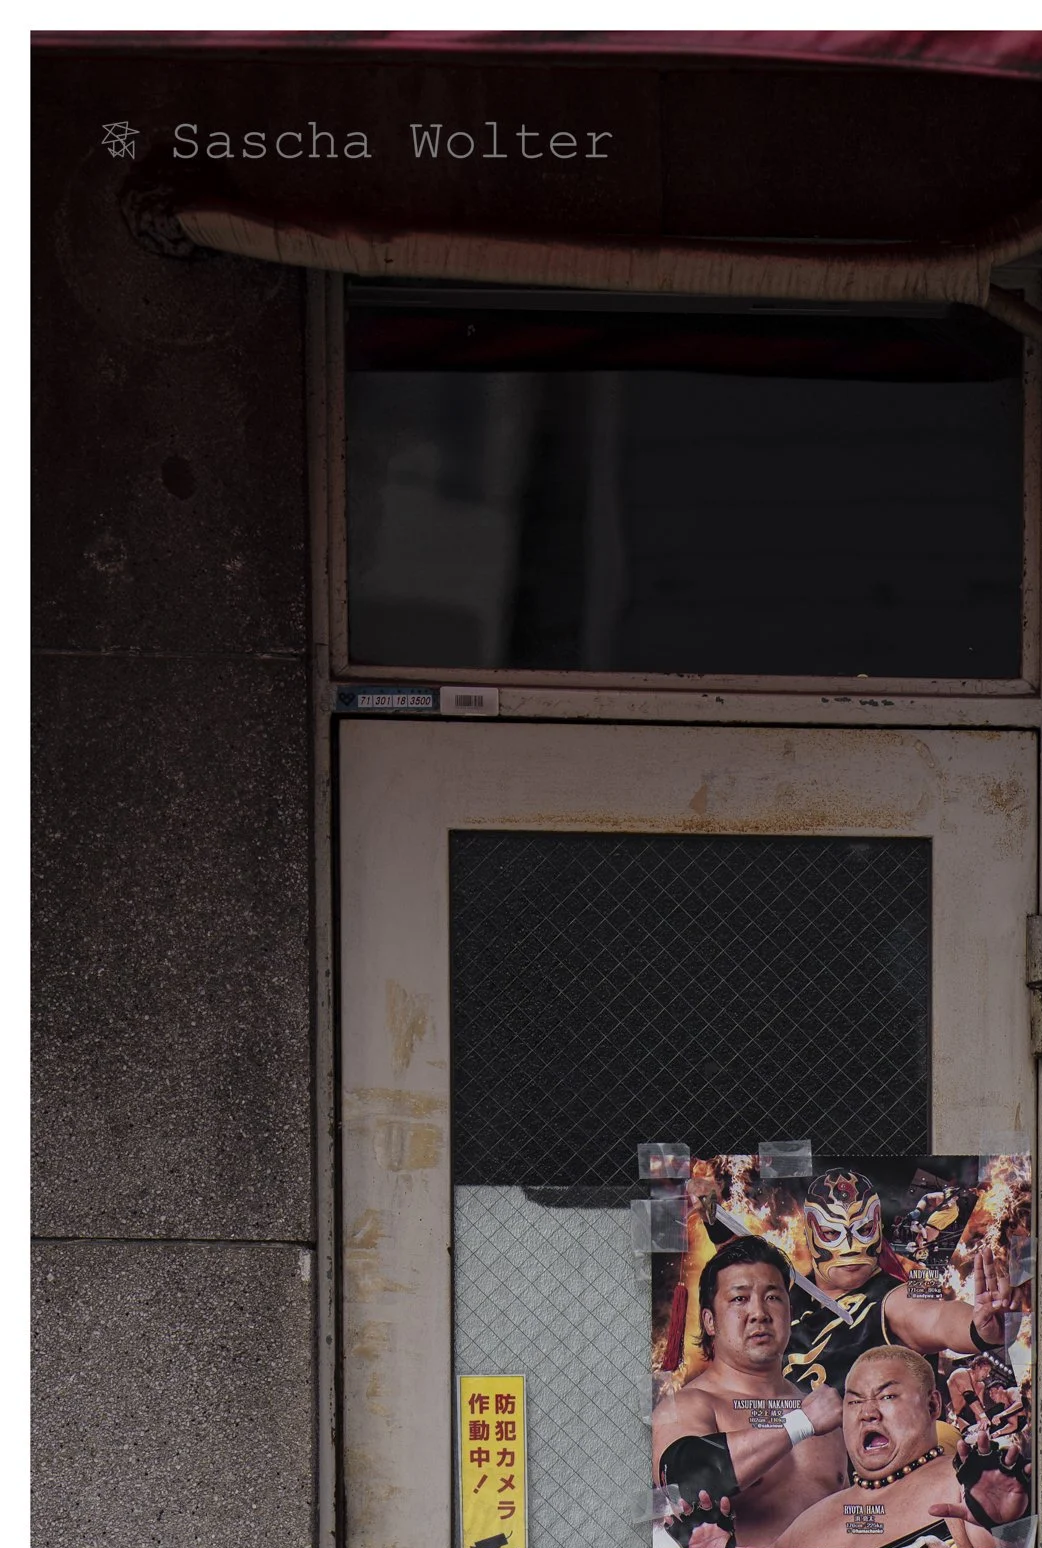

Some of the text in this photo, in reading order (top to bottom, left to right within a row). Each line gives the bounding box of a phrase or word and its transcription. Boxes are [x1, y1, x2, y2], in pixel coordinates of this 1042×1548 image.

[360, 696, 432, 706] 71 301 18 3500
[909, 1269, 939, 1279] ANDY WU
[733, 1399, 801, 1409] YASUFUMI NAKANOUE
[467, 1393, 491, 1495] 作動中！
[495, 1393, 518, 1521] 防犯カメラ
[844, 1505, 885, 1515] RYOTA HAMA
